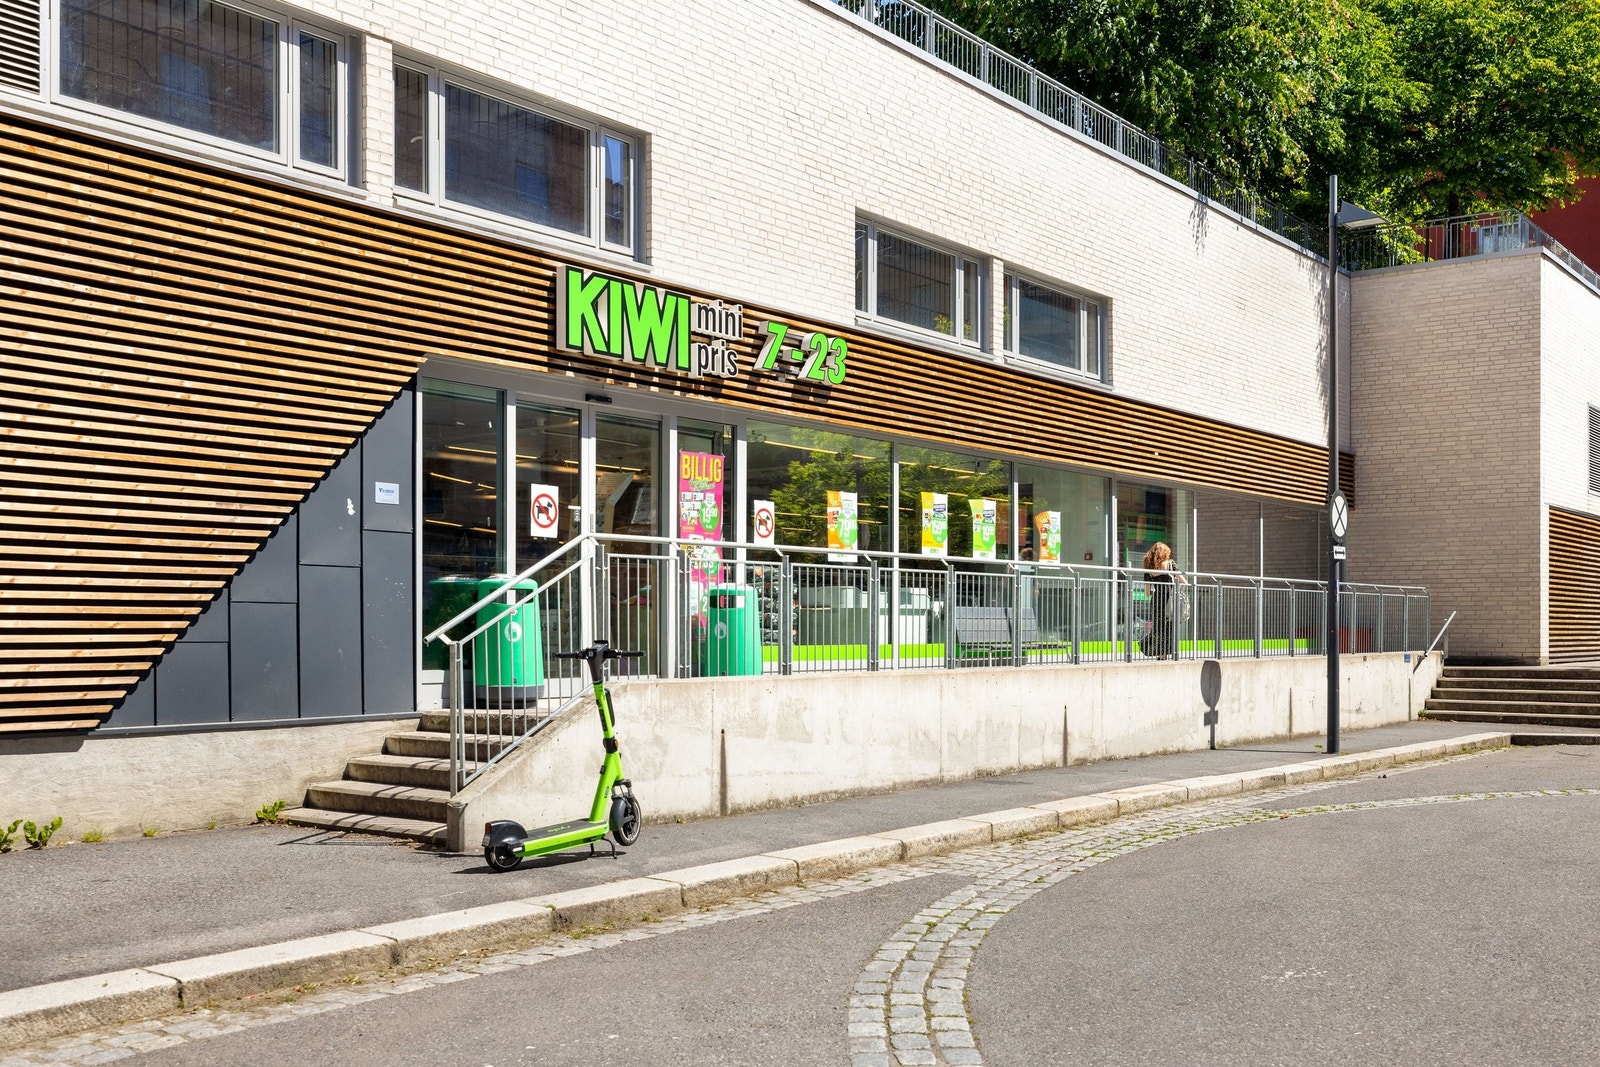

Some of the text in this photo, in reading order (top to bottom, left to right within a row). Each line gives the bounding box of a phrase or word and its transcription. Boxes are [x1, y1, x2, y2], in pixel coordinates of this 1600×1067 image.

[562, 264, 692, 373] KIWI
[697, 301, 743, 338] mini
[697, 340, 739, 377] pris
[681, 453, 723, 483] BILLIG
